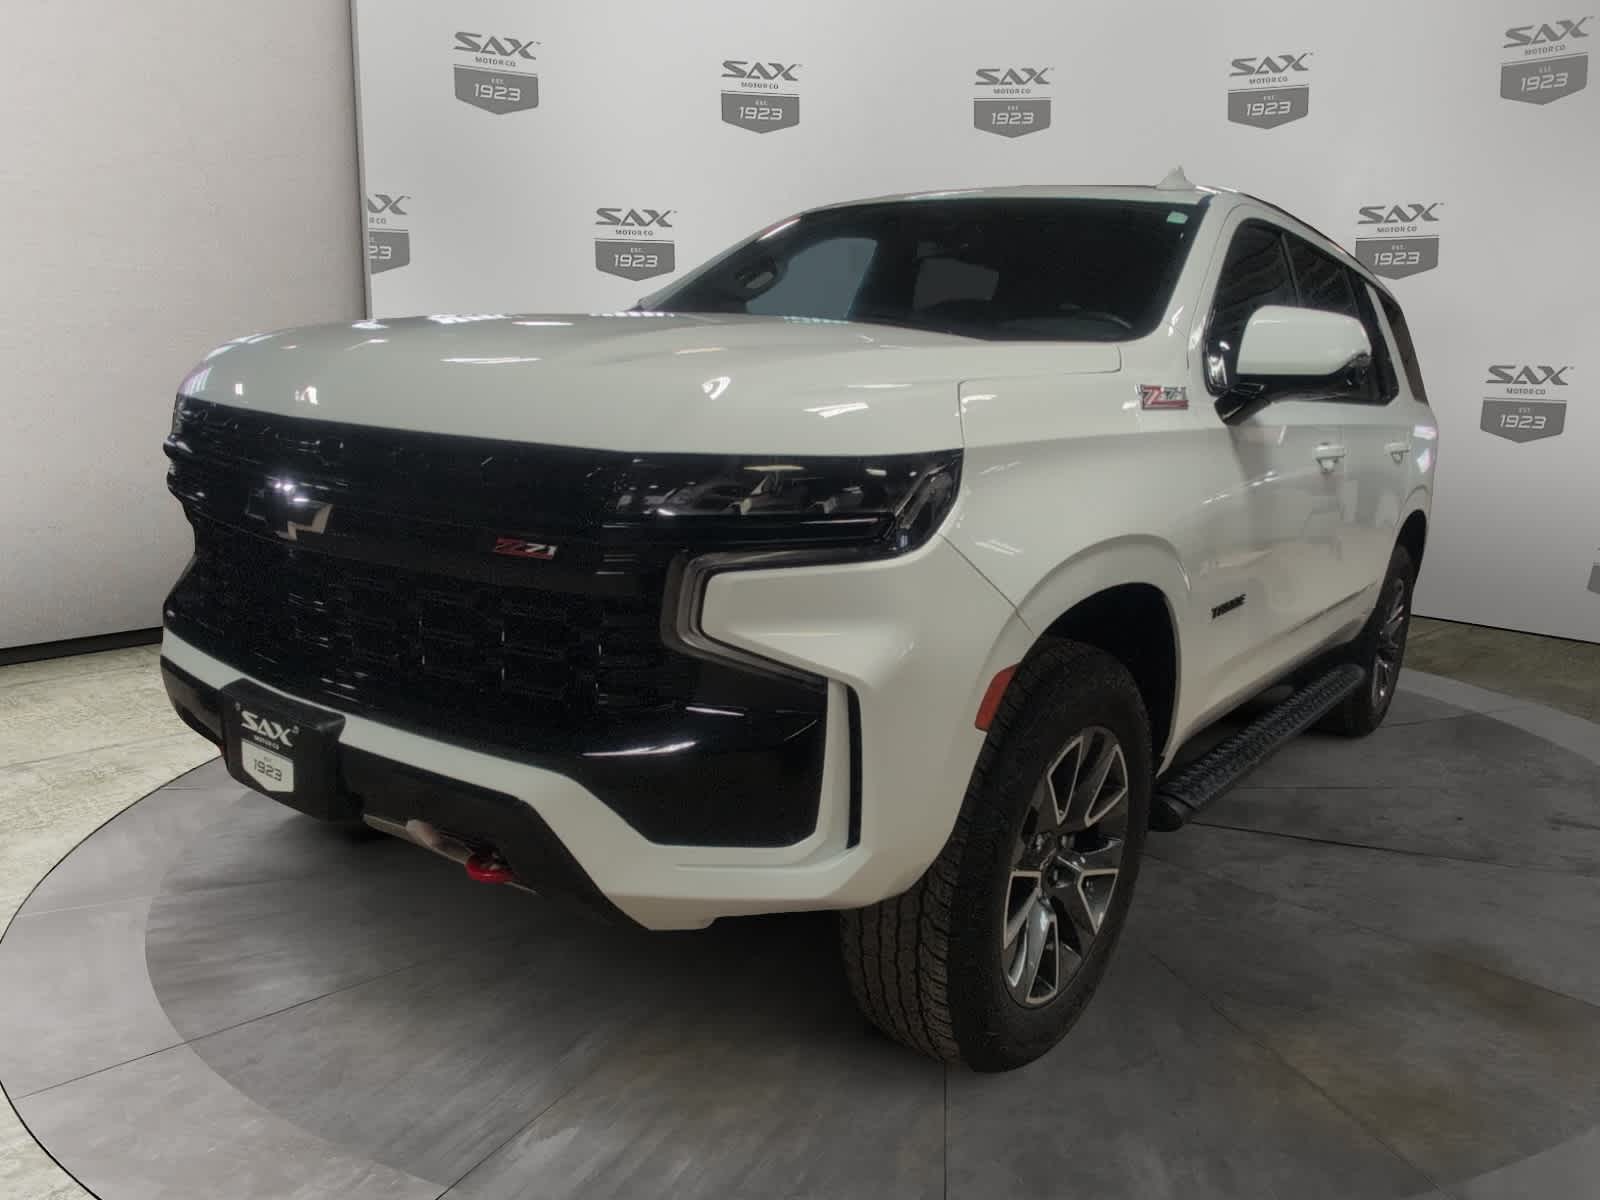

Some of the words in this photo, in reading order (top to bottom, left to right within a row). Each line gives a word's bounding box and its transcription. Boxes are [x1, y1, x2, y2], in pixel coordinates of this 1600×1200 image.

[1502, 16, 1589, 48] SAX
[453, 32, 537, 60] SAX
[721, 61, 798, 81] SAX
[1229, 53, 1309, 77] SAX
[975, 67, 1050, 85] SAX
[1521, 72, 1569, 92] 1923
[474, 83, 520, 101] 1923
[740, 106, 782, 120] 1923
[992, 112, 1034, 125] 1923
[1247, 101, 1291, 116] 1923
[595, 208, 673, 228] SAX
[1357, 202, 1440, 225] SAX
[368, 245, 392, 260] 23
[615, 254, 658, 268] 1923
[1374, 252, 1420, 265] 1923
[1485, 365, 1568, 386] SAX
[1500, 414, 1546, 429] 1923
[241, 710, 293, 748] SAX
[254, 758, 282, 782] 1923
